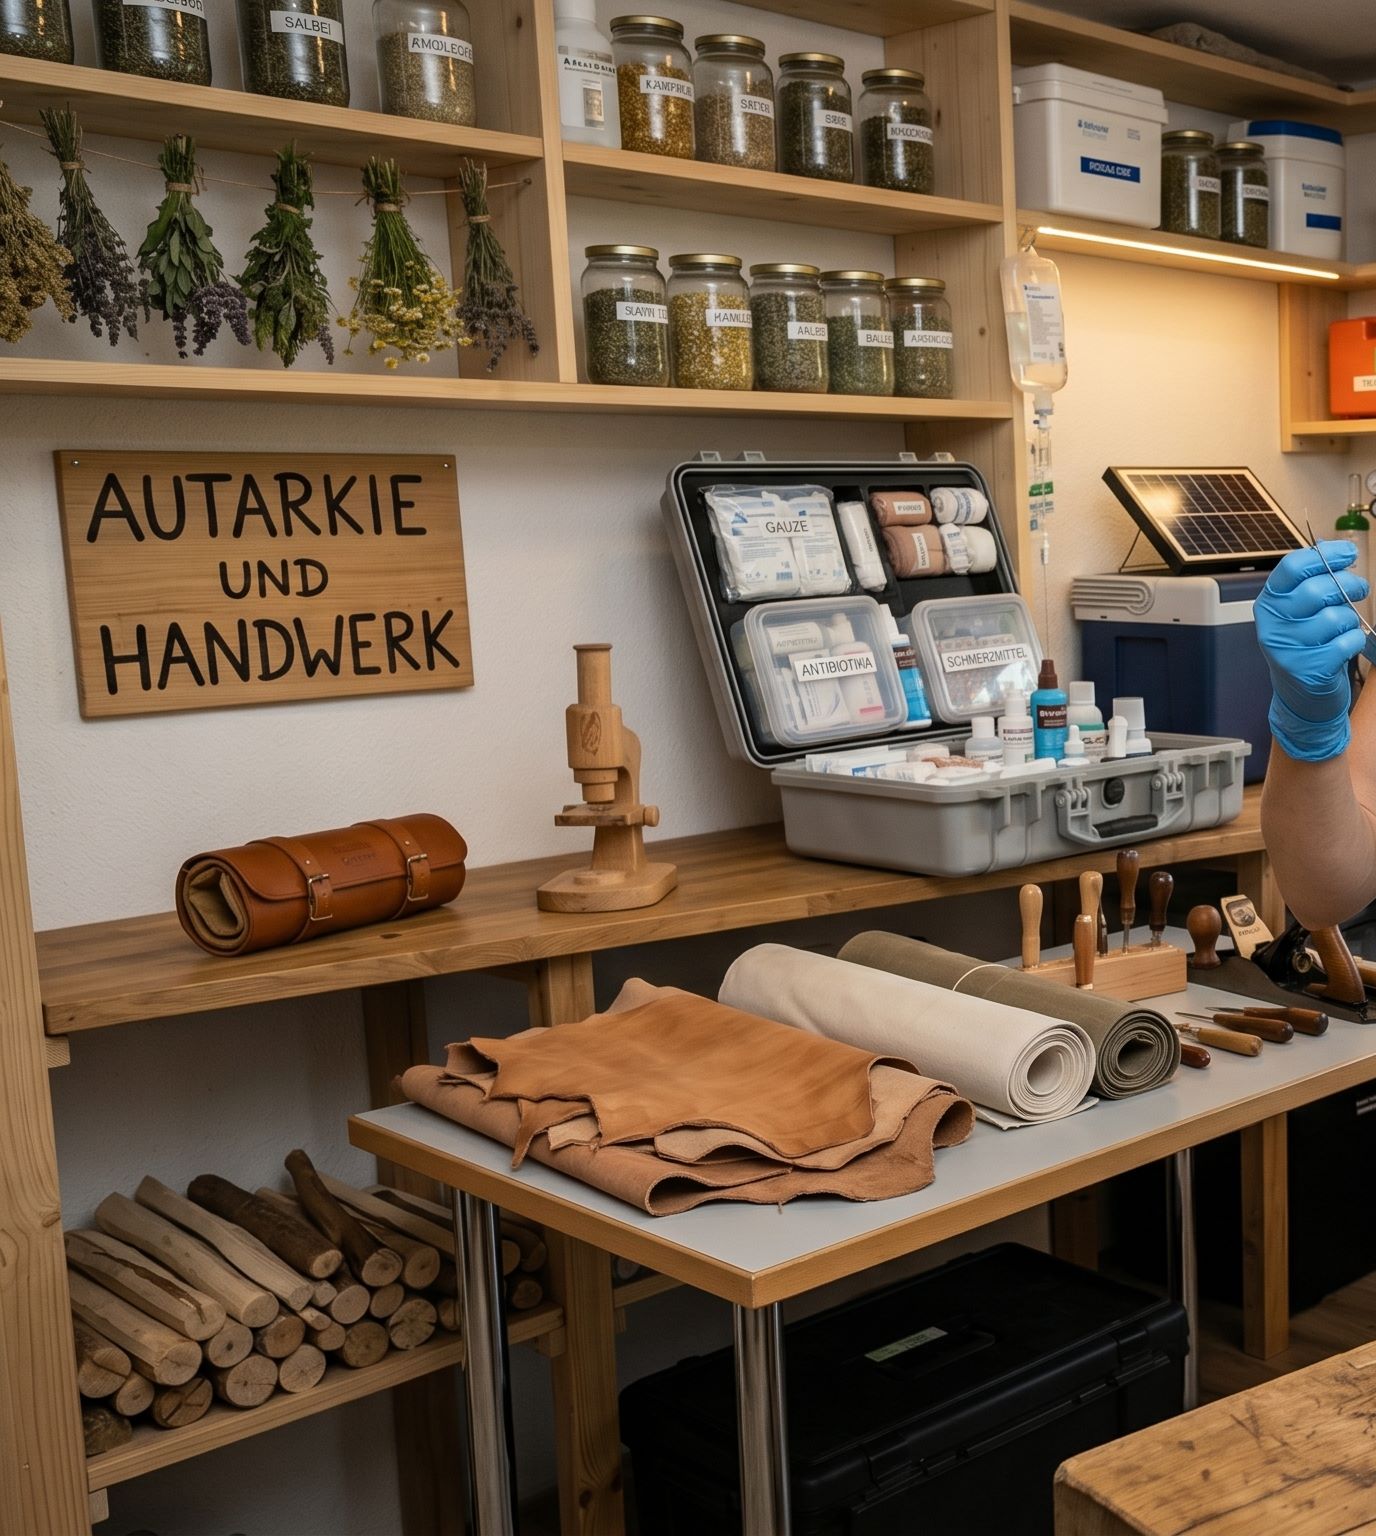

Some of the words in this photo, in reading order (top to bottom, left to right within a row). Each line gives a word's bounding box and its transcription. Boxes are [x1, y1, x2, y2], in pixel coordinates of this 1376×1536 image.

[285, 16, 331, 35] SALBEI
[86, 472, 428, 543] AUTARKIE
[765, 520, 809, 533] GAUZE
[219, 558, 329, 600] UND
[100, 609, 460, 696] HANDWERK
